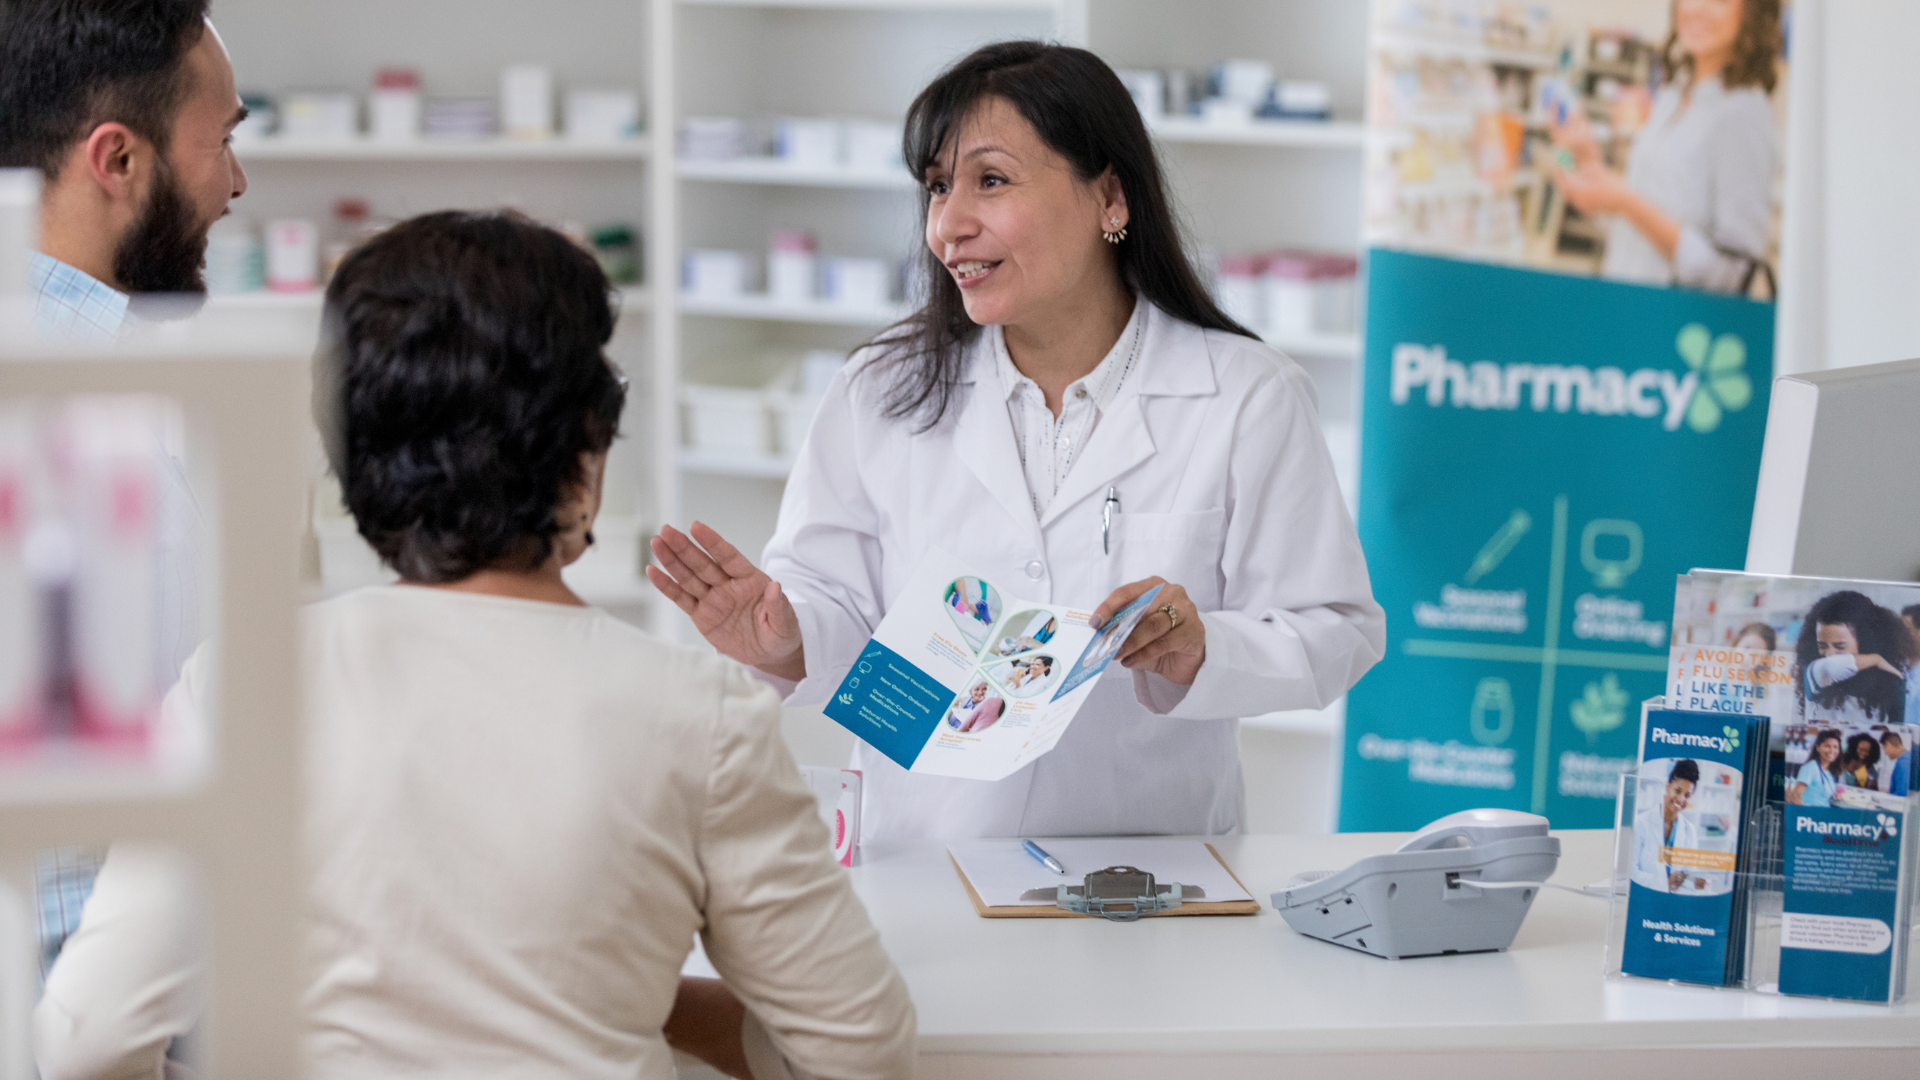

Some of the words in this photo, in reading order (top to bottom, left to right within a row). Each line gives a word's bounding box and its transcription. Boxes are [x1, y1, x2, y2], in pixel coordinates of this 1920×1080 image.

[1392, 343, 1699, 430] Pharmacy
[1694, 649, 1744, 664] AVOID
[1749, 653, 1786, 668] THIS
[887, 663, 911, 680] Seasonal
[909, 678, 942, 701] Vaccinations
[1693, 665, 1722, 678] FLU
[1727, 668, 1792, 685] SEASON
[879, 676, 892, 686] New
[891, 684, 908, 698] Online
[906, 695, 931, 714] Ordering
[1691, 681, 1728, 695] LIKE
[1732, 684, 1765, 699] THE
[868, 694, 900, 716] Medications
[1690, 697, 1754, 714] PLAGUE
[858, 710, 882, 728] Solutions
[861, 706, 881, 721] Natural
[880, 719, 899, 732] Health
[1651, 727, 1728, 752] Pharmacy
[1796, 816, 1882, 841] Pharmacy
[1642, 919, 1673, 931] Health
[1674, 922, 1715, 936] Solutions
[1654, 932, 1662, 942] &
[1663, 933, 1701, 947] Services
